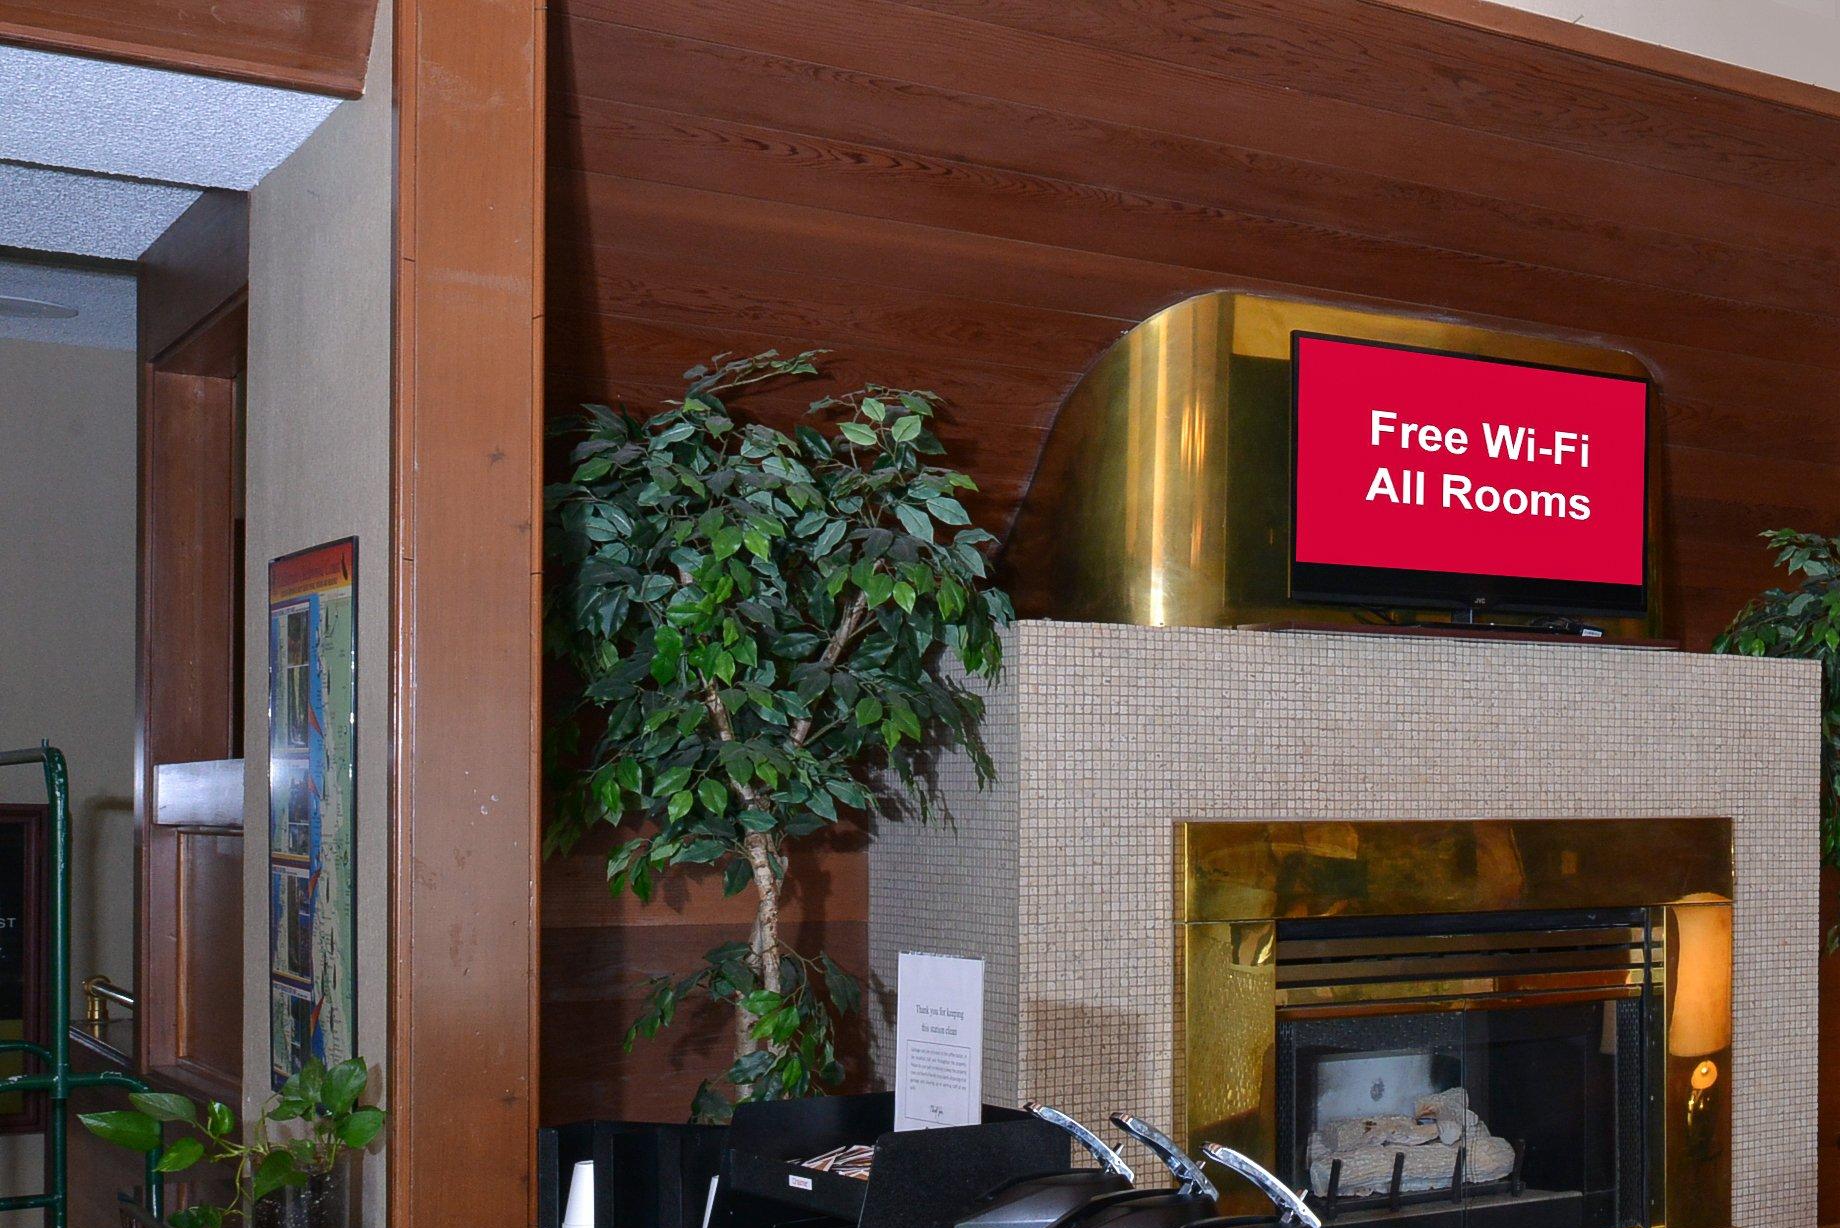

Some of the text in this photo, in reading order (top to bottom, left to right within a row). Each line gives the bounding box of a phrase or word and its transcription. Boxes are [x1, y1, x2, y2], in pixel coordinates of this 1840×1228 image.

[1370, 410, 1590, 467] Free Wi-Fi
[1366, 467, 1591, 521] All Rooms
[916, 1004, 929, 1014] Thank
